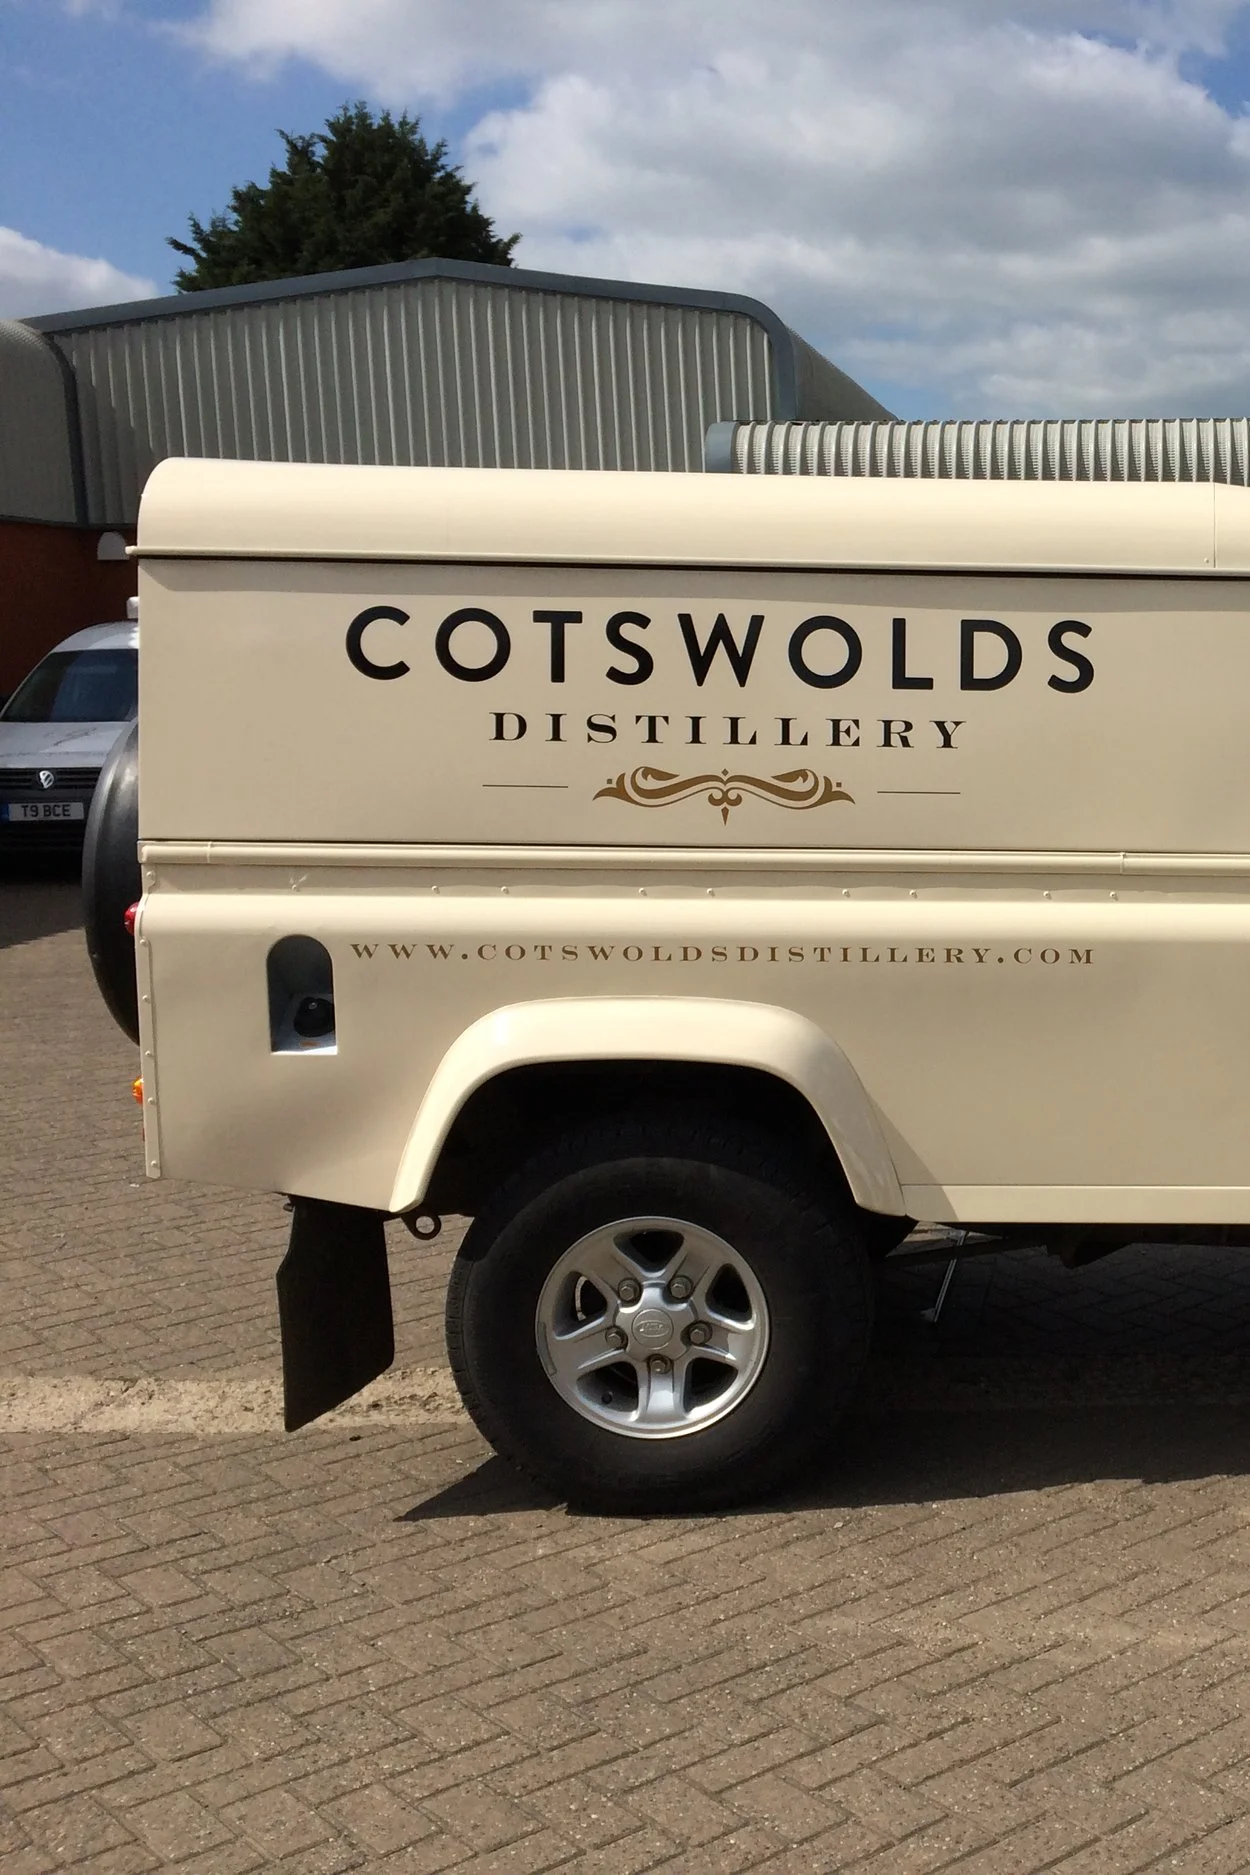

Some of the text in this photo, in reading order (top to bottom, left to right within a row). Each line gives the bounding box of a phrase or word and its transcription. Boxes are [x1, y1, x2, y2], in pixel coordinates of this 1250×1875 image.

[345, 605, 1095, 694] COTSWOLDS
[489, 712, 966, 749] DISTILLERY
[21, 804, 71, 817] T9 BCE
[350, 943, 1095, 965] WWW.COTSWOLDSDISTILLERY.COM
